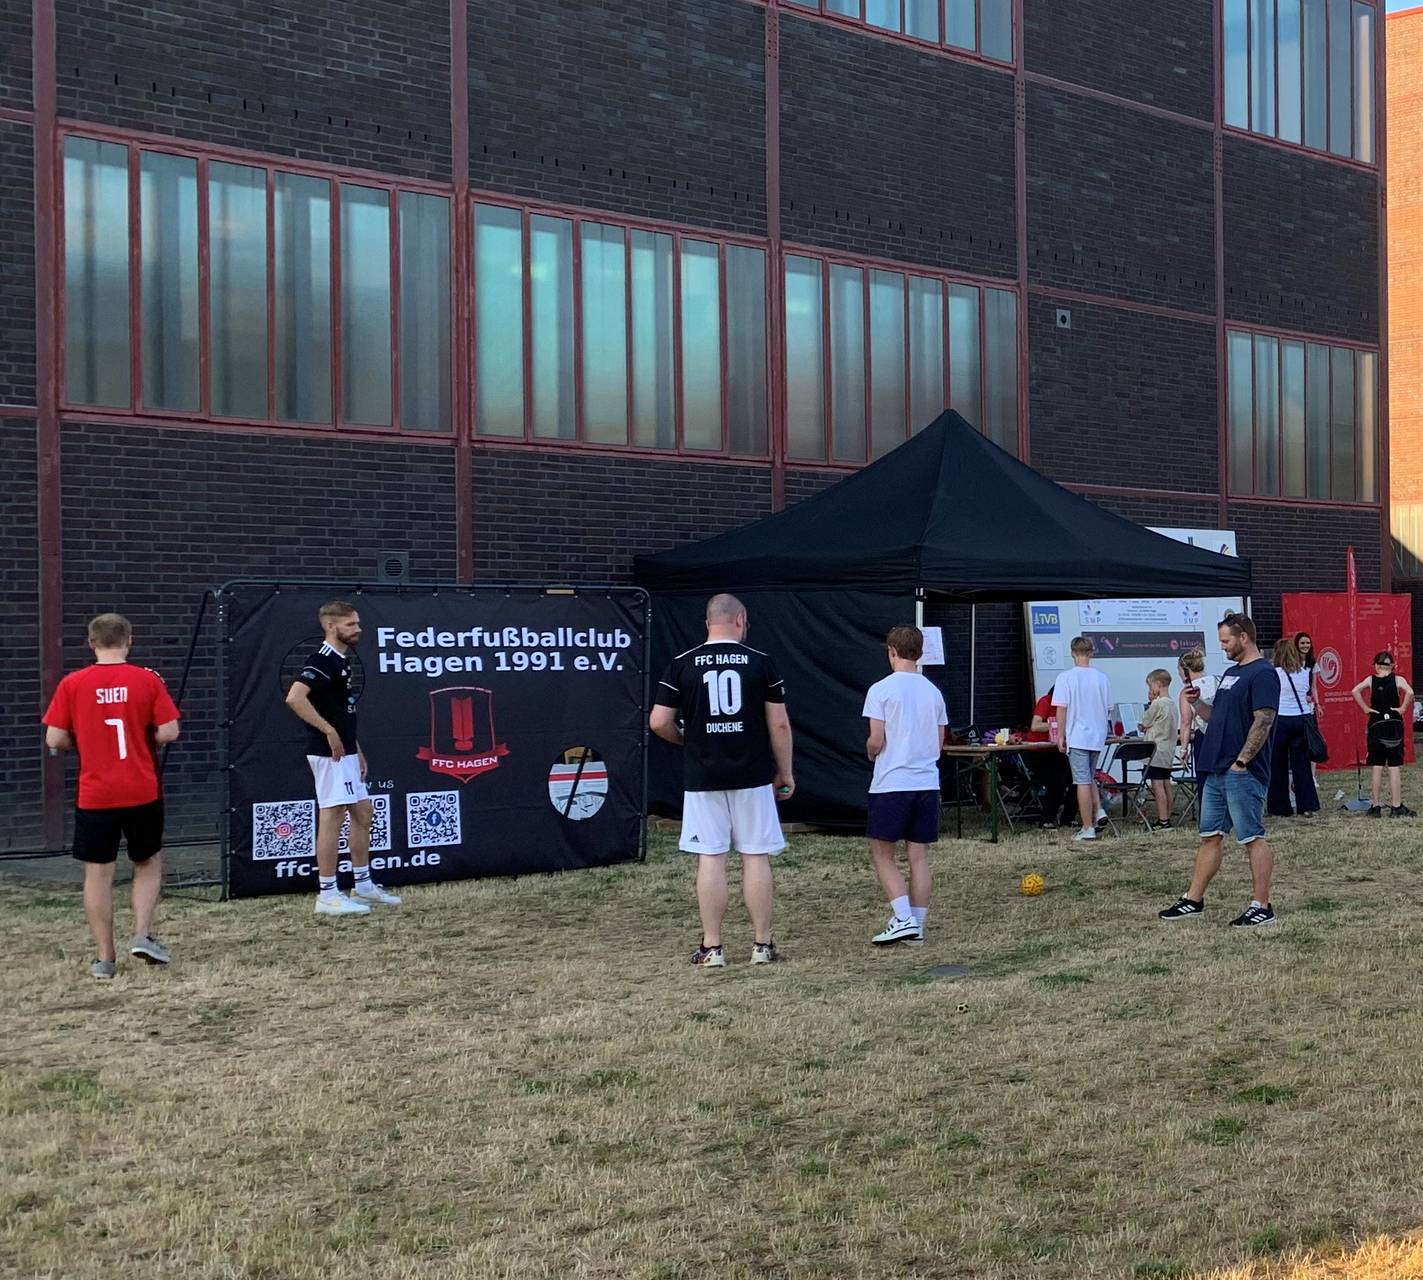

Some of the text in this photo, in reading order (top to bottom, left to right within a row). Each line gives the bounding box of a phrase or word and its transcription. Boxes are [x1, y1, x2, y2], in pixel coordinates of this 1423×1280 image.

[377, 627, 631, 648] Federfußballclub
[379, 652, 623, 677] Hagen 1991 e.V.
[695, 654, 748, 666] FFC HAGEN
[702, 669, 742, 716] 10
[706, 722, 743, 733] DUCHENE
[432, 756, 498, 768] FFC HAGEN
[344, 781, 355, 796] 11
[275, 850, 441, 878] ffc-aen.de
